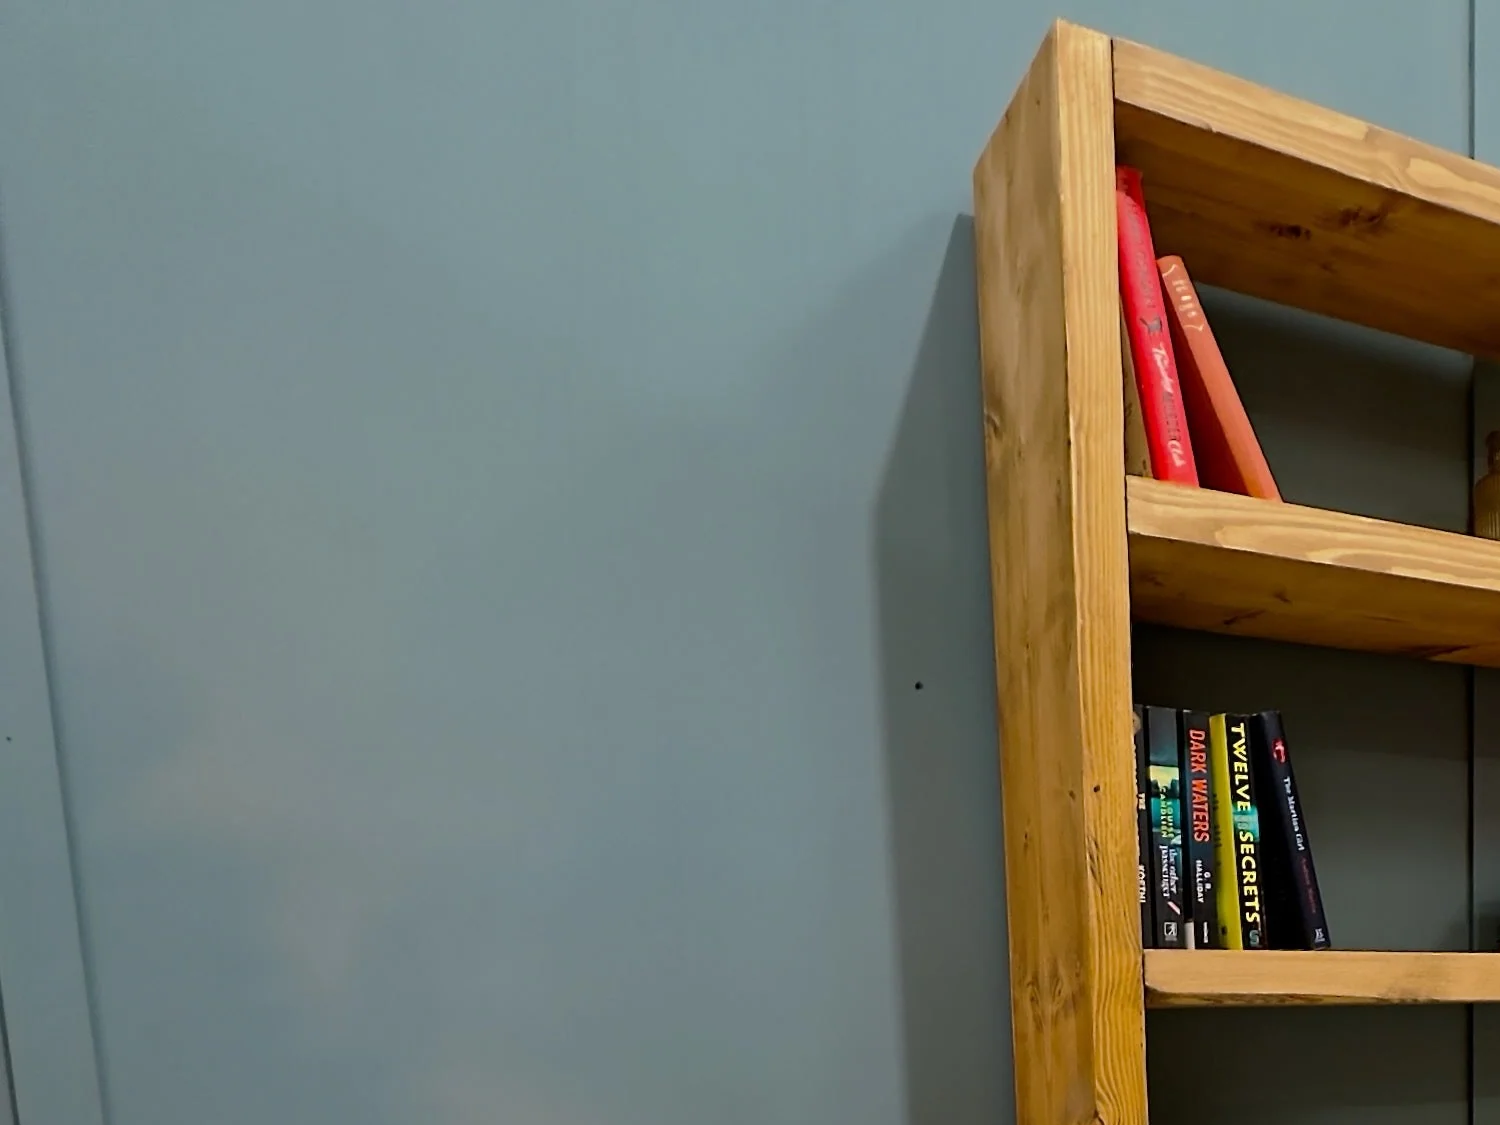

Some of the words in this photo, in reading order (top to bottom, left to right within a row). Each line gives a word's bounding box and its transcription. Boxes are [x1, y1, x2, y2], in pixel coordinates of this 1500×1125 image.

[1189, 728, 1208, 774] DARK
[1231, 722, 1251, 812] TWELVE
[1191, 778, 1210, 843] WATERS
[1296, 833, 1306, 851] Girl
[1195, 859, 1205, 903] HALLIDAY
[1239, 830, 1261, 923] SECRETS
